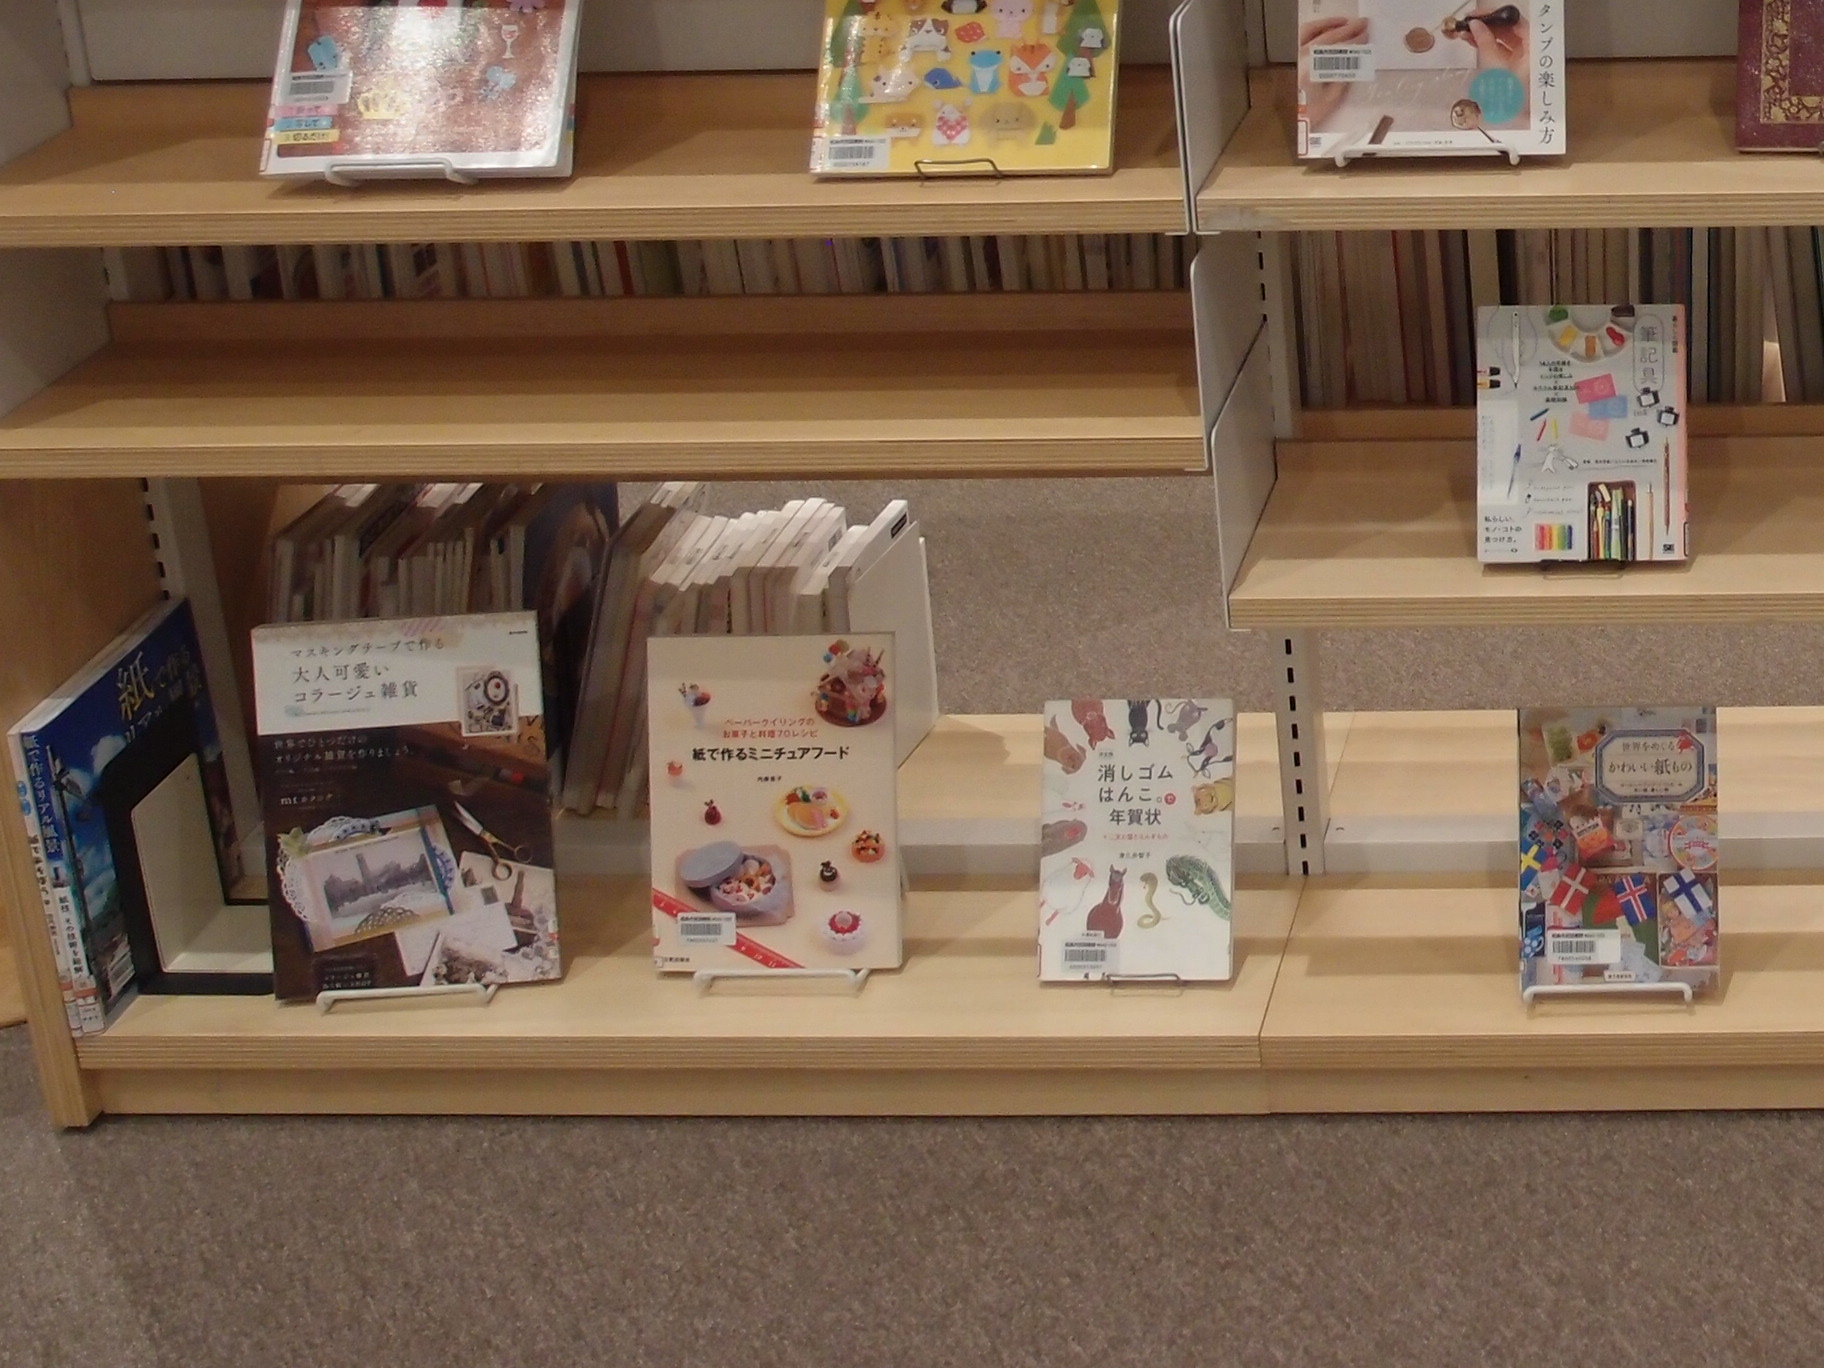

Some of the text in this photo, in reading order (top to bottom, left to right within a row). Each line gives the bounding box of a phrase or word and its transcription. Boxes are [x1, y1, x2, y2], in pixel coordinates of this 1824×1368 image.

[290, 636, 445, 658] マスキングテープで作る
[292, 661, 390, 684] 大人可愛い
[294, 679, 419, 704] コラージュ雑貨
[691, 745, 850, 762] 紙で作るミニチュアフード
[1097, 763, 1174, 783] 消しゴム
[1608, 758, 1693, 776] かわいい紙もの
[1098, 785, 1163, 804] はんこ。
[1109, 808, 1162, 826] 年賀状
